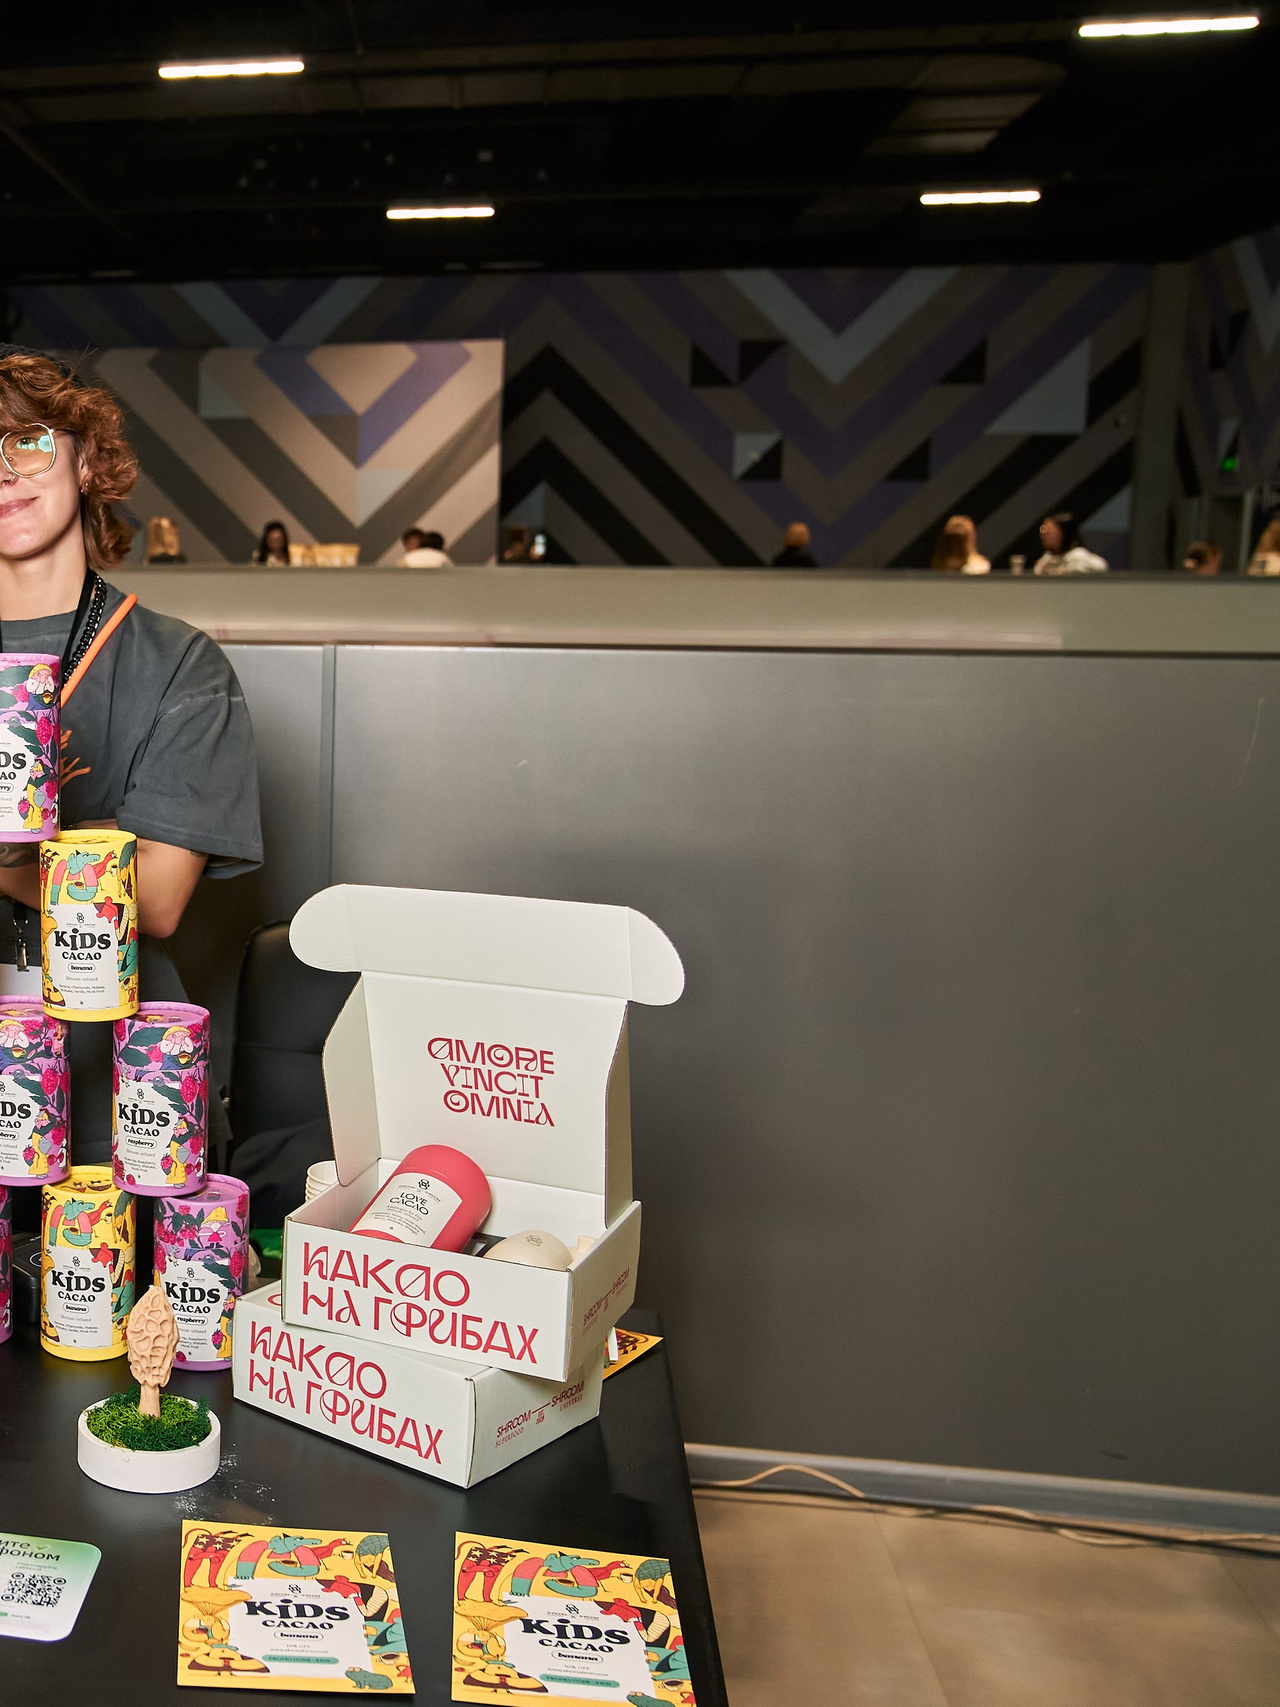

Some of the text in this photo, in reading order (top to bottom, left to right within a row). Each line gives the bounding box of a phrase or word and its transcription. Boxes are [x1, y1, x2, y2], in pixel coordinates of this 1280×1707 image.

[62, 951, 102, 960] CACAO
[427, 1037, 554, 1074] AMORE
[440, 1063, 543, 1098] VINCIT
[443, 1089, 555, 1127] OMNIA
[123, 1124, 160, 1137] CACAO
[128, 1139, 154, 1147] raspberry
[390, 1197, 429, 1215] CACAO
[400, 1192, 428, 1206] LOVE
[303, 1241, 471, 1307] КАКАО
[58, 1291, 96, 1302] CACAO
[172, 1303, 211, 1314] CACAO
[177, 1316, 206, 1324] raspberry
[302, 1281, 539, 1365] НА ГРИБАХ
[250, 1321, 388, 1399] КАКАО
[248, 1359, 443, 1465] НА ГРИБАХ
[496, 1380, 585, 1438] SHROOM SHROOM
[261, 1620, 334, 1630] CACAO
[539, 1639, 614, 1653] CACAO
[558, 1652, 599, 1661] banana
